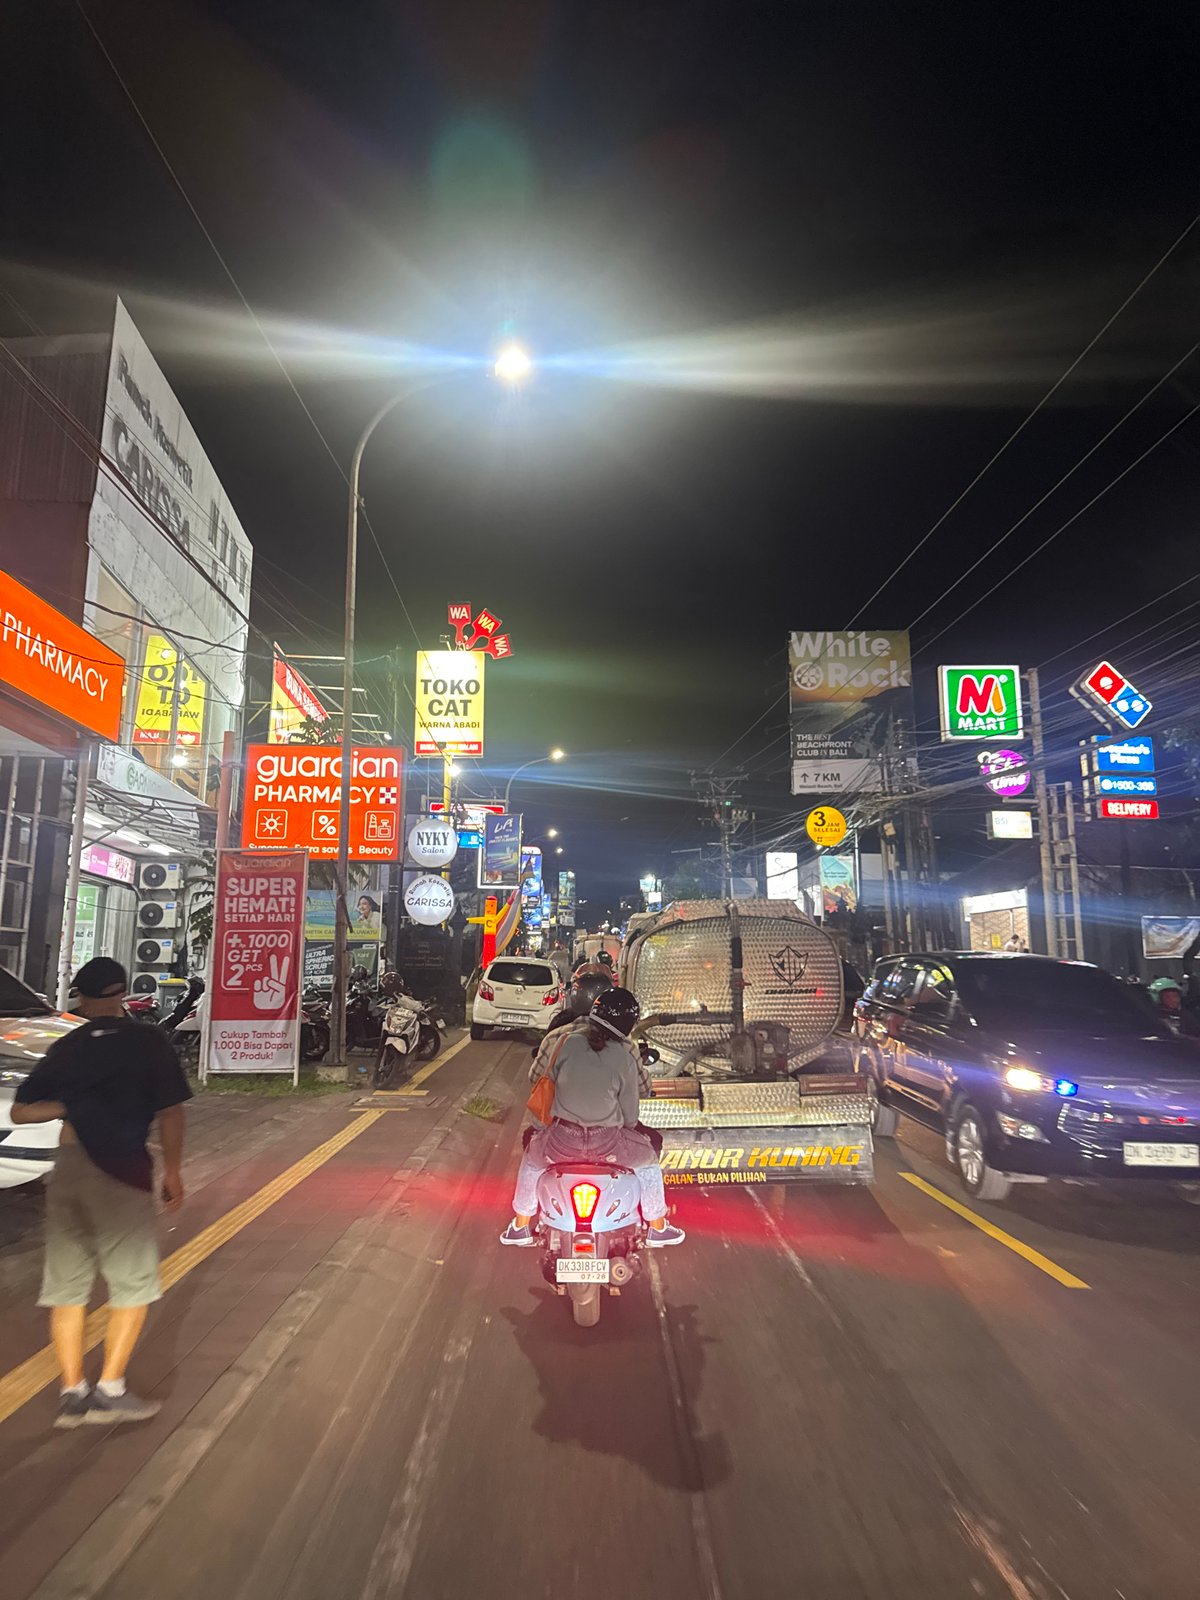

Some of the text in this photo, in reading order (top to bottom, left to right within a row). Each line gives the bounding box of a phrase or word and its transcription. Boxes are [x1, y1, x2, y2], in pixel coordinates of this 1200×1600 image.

[450, 607, 469, 619] WA
[477, 613, 495, 634] WA
[494, 636, 509, 657] WA
[790, 631, 891, 658] White
[3, 611, 109, 702] PHARMACY
[828, 660, 911, 688] Rock
[420, 679, 481, 696] TOKO
[427, 699, 473, 717] CAT
[418, 721, 480, 729] WARNA ABADI
[958, 717, 1006, 731] MART
[796, 741, 853, 749] BEACHFRONT
[796, 749, 819, 757] CLUB
[814, 773, 840, 782] 7 KM
[254, 785, 375, 804] PHARMACY
[1107, 802, 1151, 816] DELIVERY
[813, 811, 826, 827] 3
[416, 832, 450, 846] NYKY
[359, 845, 394, 856] Beauty
[226, 877, 296, 896] SUPER
[409, 880, 427, 895] Rumah
[224, 897, 296, 913] HEMAT!
[406, 897, 453, 908] CARISSA
[224, 913, 295, 923] SETIAP HARI
[248, 933, 289, 948] 1000
[227, 949, 261, 963] GET
[226, 963, 264, 987] 2 PCS
[220, 1030, 288, 1040] Cukup Tambah
[214, 1040, 293, 1051] 1.000 Bisa Dapat
[231, 1050, 274, 1060] 2 Produk!
[747, 1145, 864, 1168] KUNING
[663, 1171, 767, 1185] GALAN BUKAN PILIHAN
[558, 1261, 570, 1272] DK
